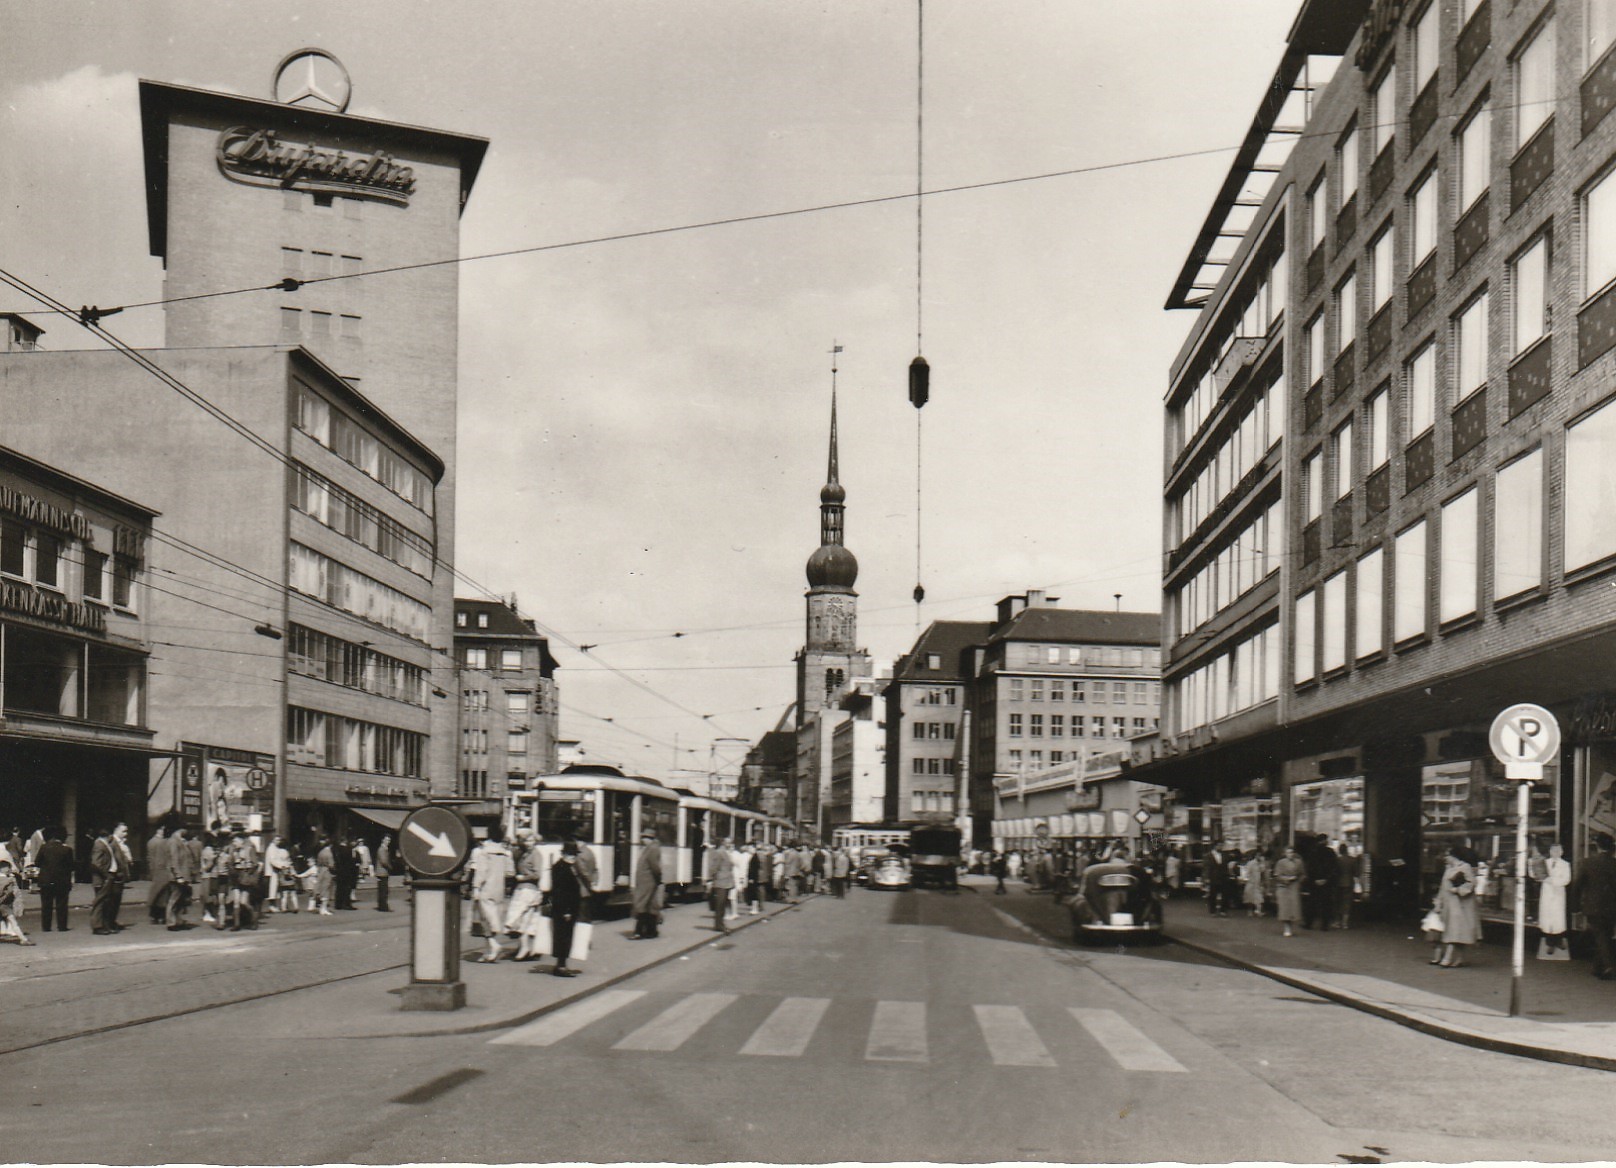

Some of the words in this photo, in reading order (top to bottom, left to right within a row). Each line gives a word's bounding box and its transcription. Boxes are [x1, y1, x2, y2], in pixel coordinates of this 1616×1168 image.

[217, 125, 415, 195] Dujardin
[0, 485, 93, 540] UFMÄNNISCHE
[0, 580, 67, 623] KENKASSE
[1518, 718, 1541, 757] P
[252, 771, 263, 787] H
